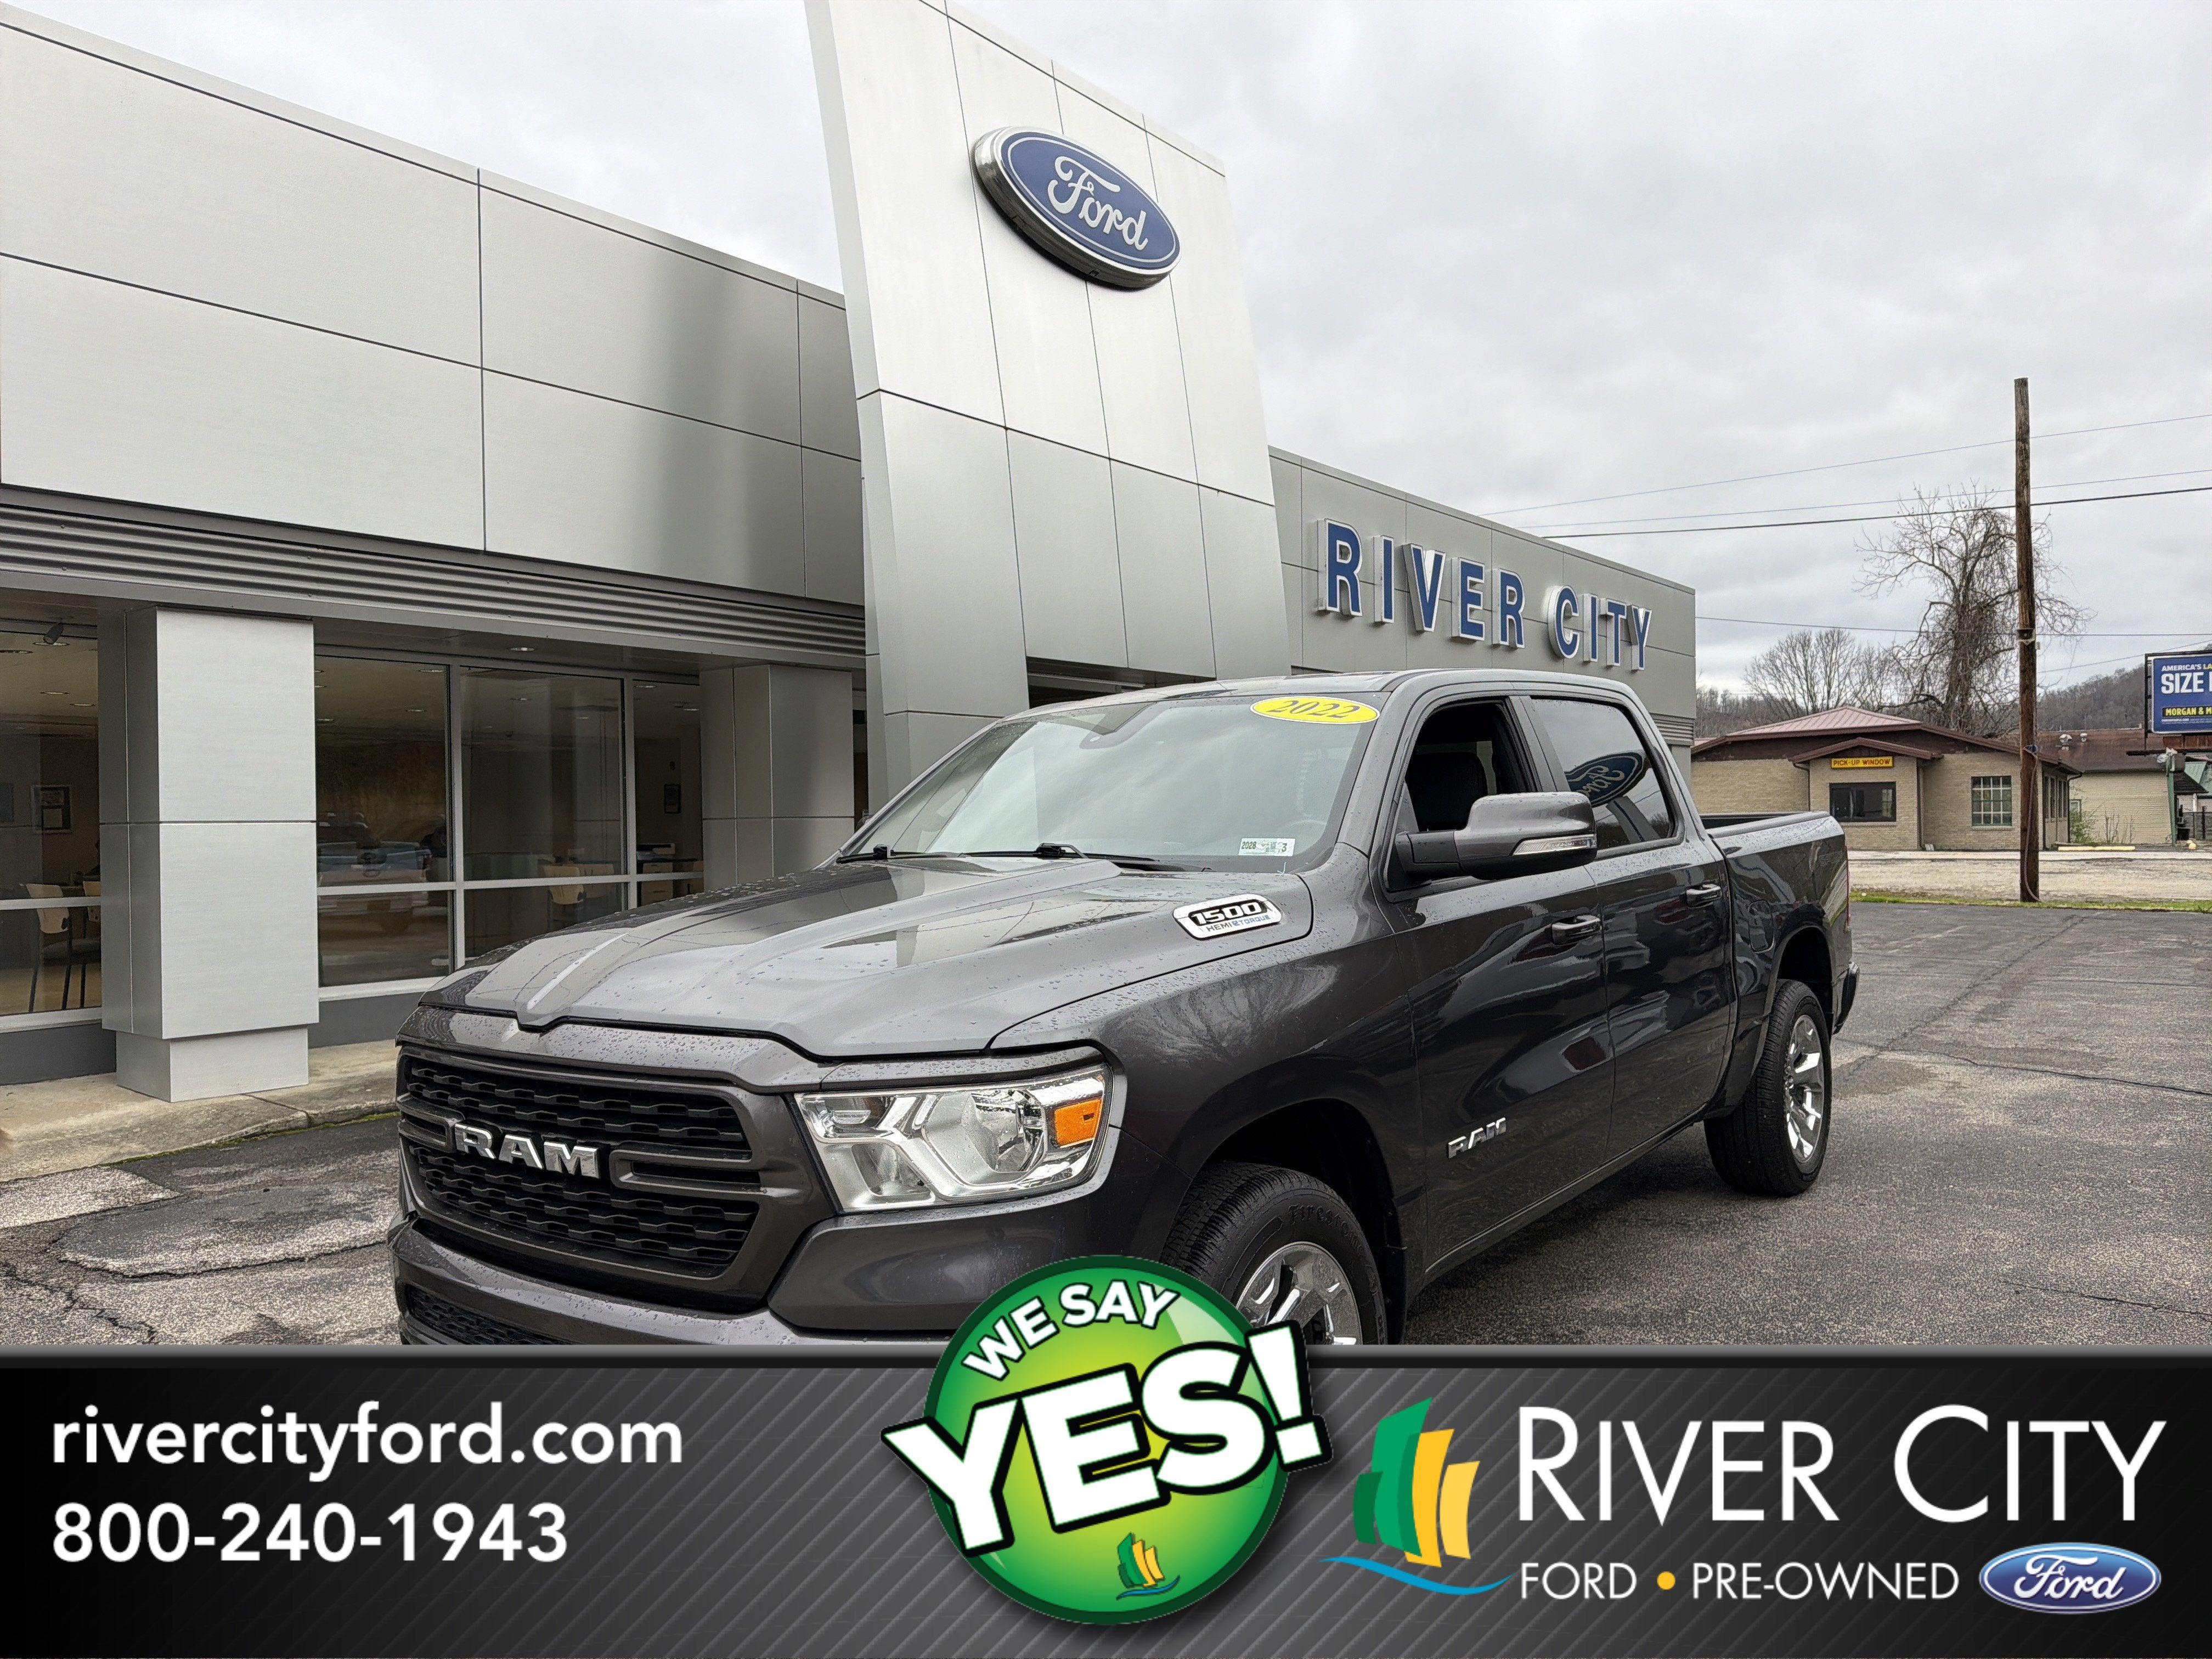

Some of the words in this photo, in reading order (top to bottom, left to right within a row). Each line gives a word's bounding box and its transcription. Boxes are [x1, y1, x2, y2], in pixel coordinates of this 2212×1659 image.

[1047, 156, 1148, 251] Ford
[1318, 517, 1526, 648] RIVER
[1548, 585, 1652, 671] CITY
[2161, 672, 2204, 694] SIZE
[1266, 700, 1361, 718] 2022
[2165, 708, 2197, 716] MORGAN
[1192, 902, 1261, 925] 1500
[1206, 922, 1232, 932] HEMI
[1447, 1117, 1506, 1159] RAM
[454, 1123, 600, 1180] RAM
